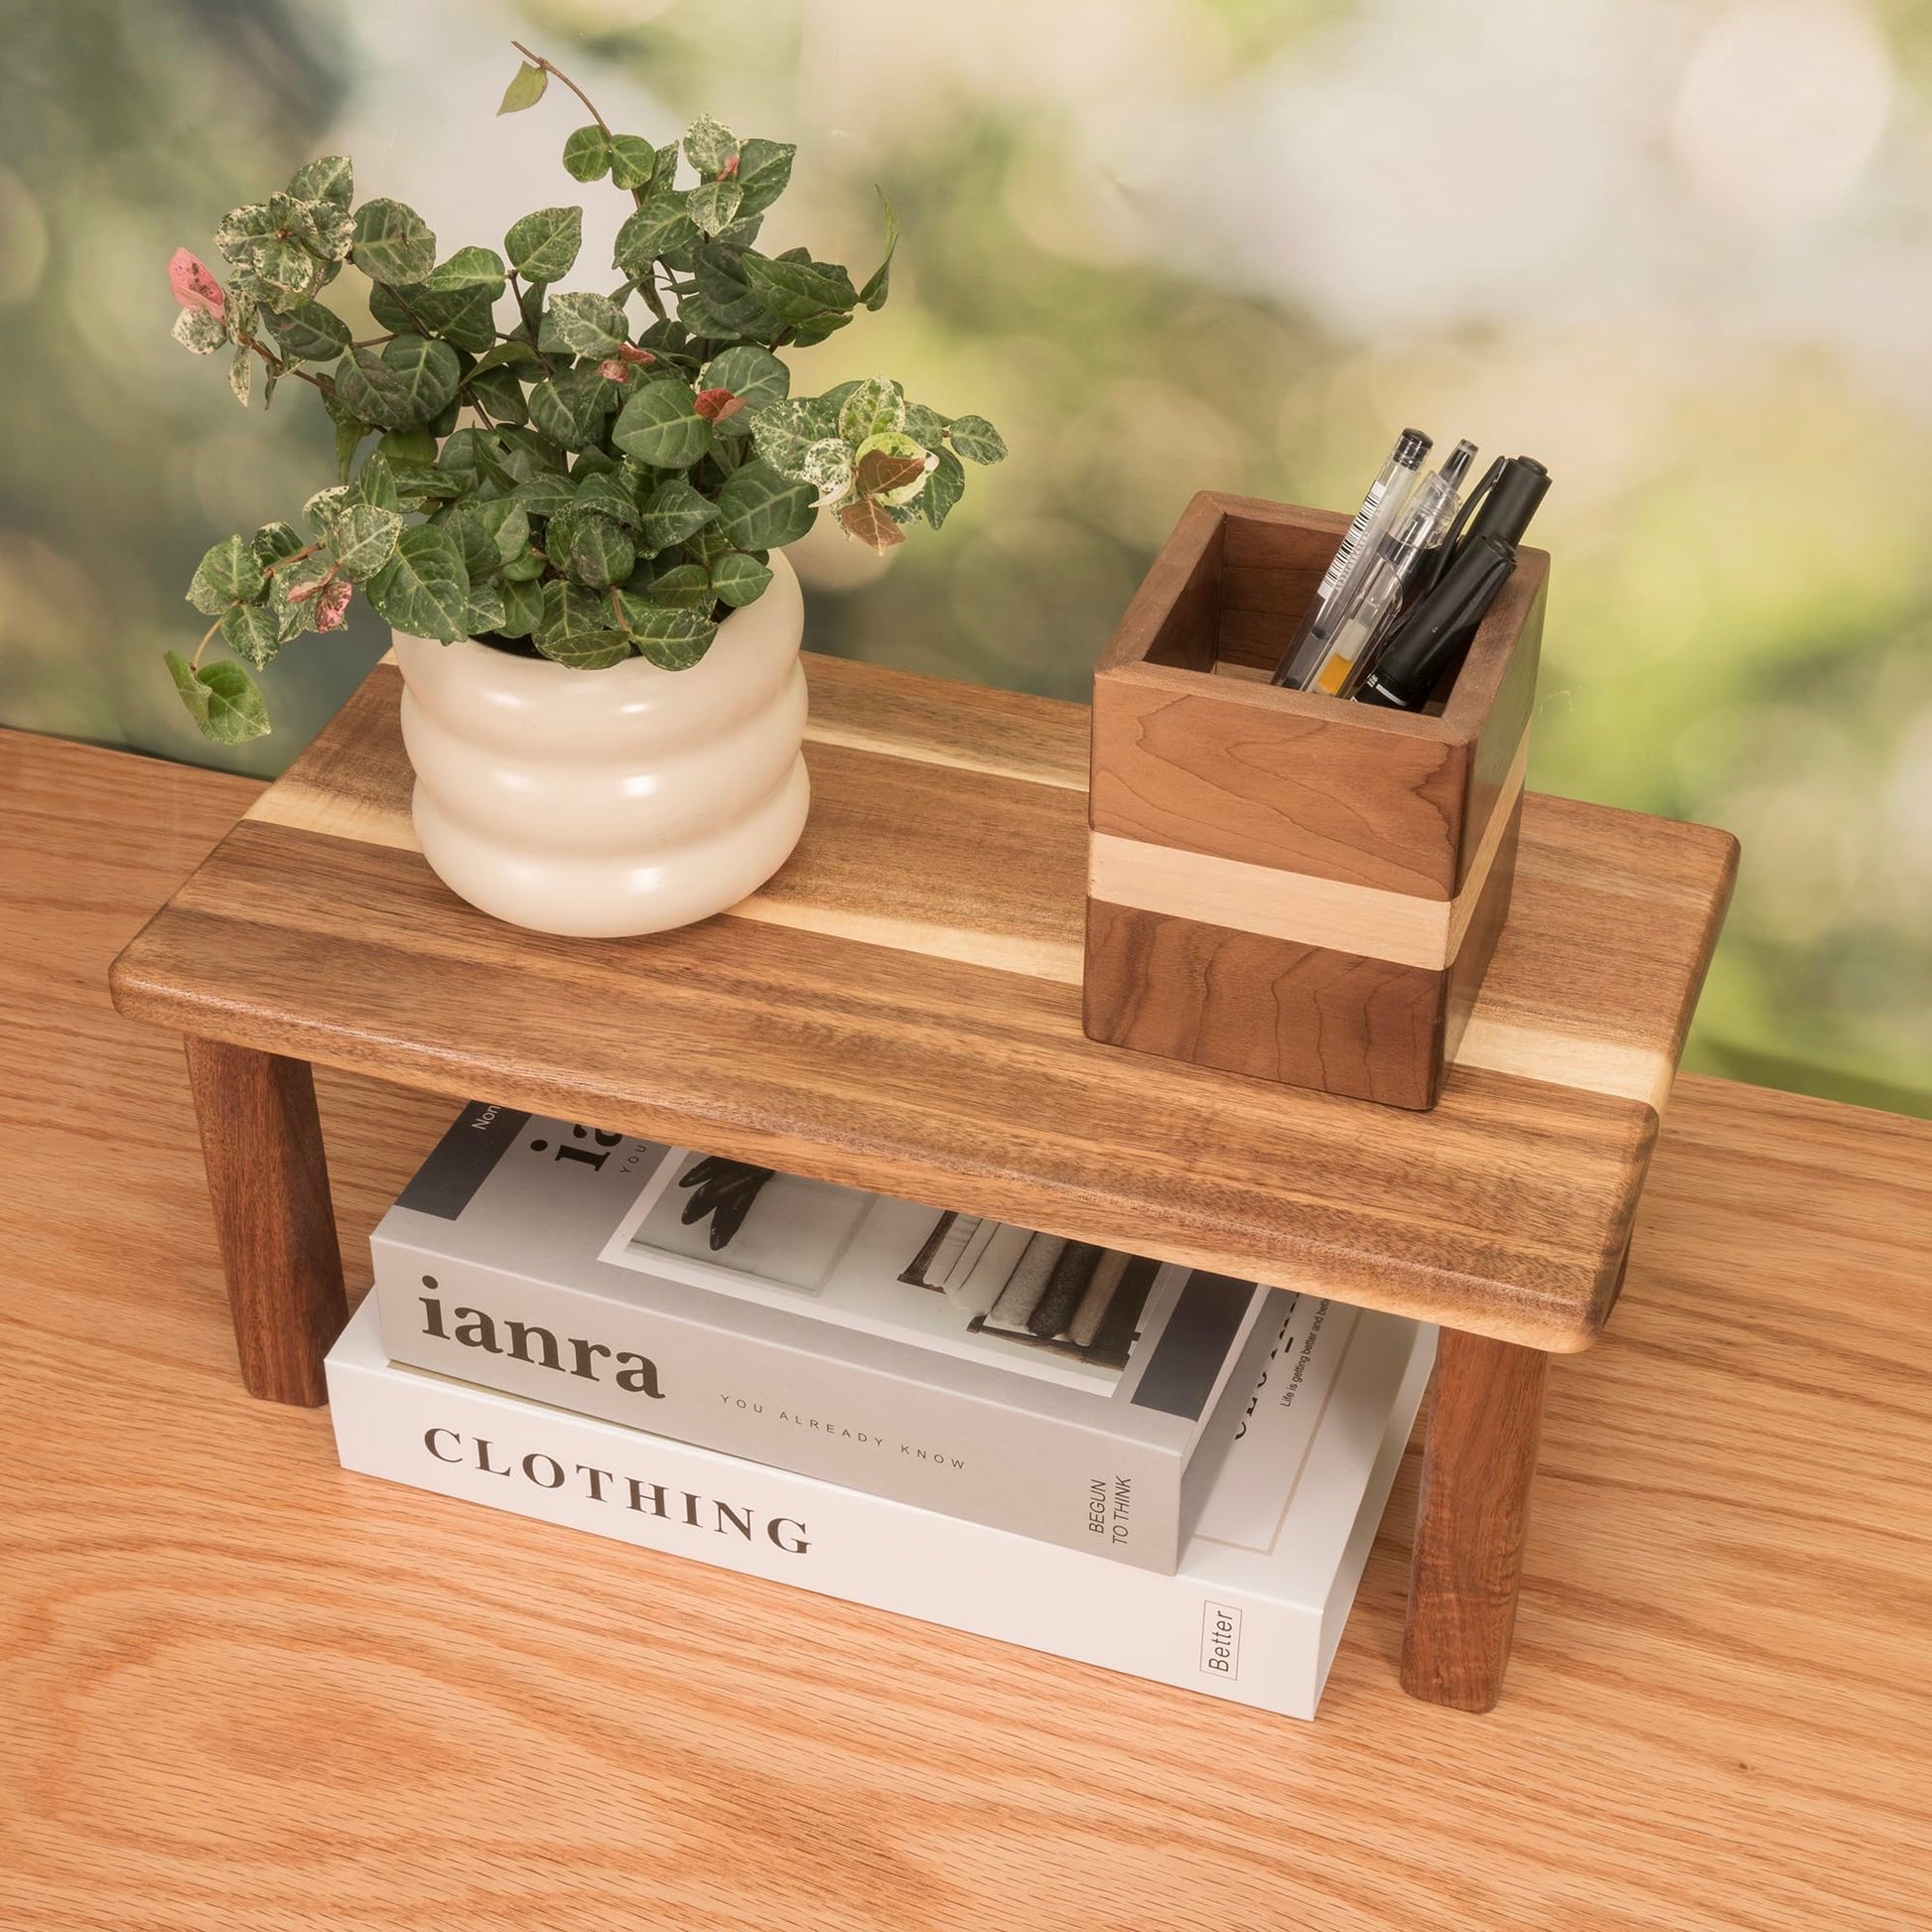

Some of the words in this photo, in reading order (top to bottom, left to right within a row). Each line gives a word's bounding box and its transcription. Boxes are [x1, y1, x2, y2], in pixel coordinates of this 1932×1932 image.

[620, 1145, 646, 1174] YOU
[1315, 1299, 1330, 1315] bett
[418, 1275, 666, 1400] ianra
[1311, 1315, 1323, 1332] and
[1301, 1331, 1317, 1355] better
[1292, 1355, 1311, 1383] getting
[1280, 1392, 1295, 1408] Life
[1290, 1383, 1299, 1392] is
[721, 1394, 763, 1414] YOU
[779, 1411, 884, 1448] ALREADY
[900, 1445, 965, 1470] KNOW
[424, 1428, 812, 1555] CLOTHING
[1113, 1475, 1132, 1520] THINK
[1088, 1478, 1106, 1534] BEGUN
[1112, 1525, 1129, 1544] TO
[1208, 1610, 1233, 1673] Better
